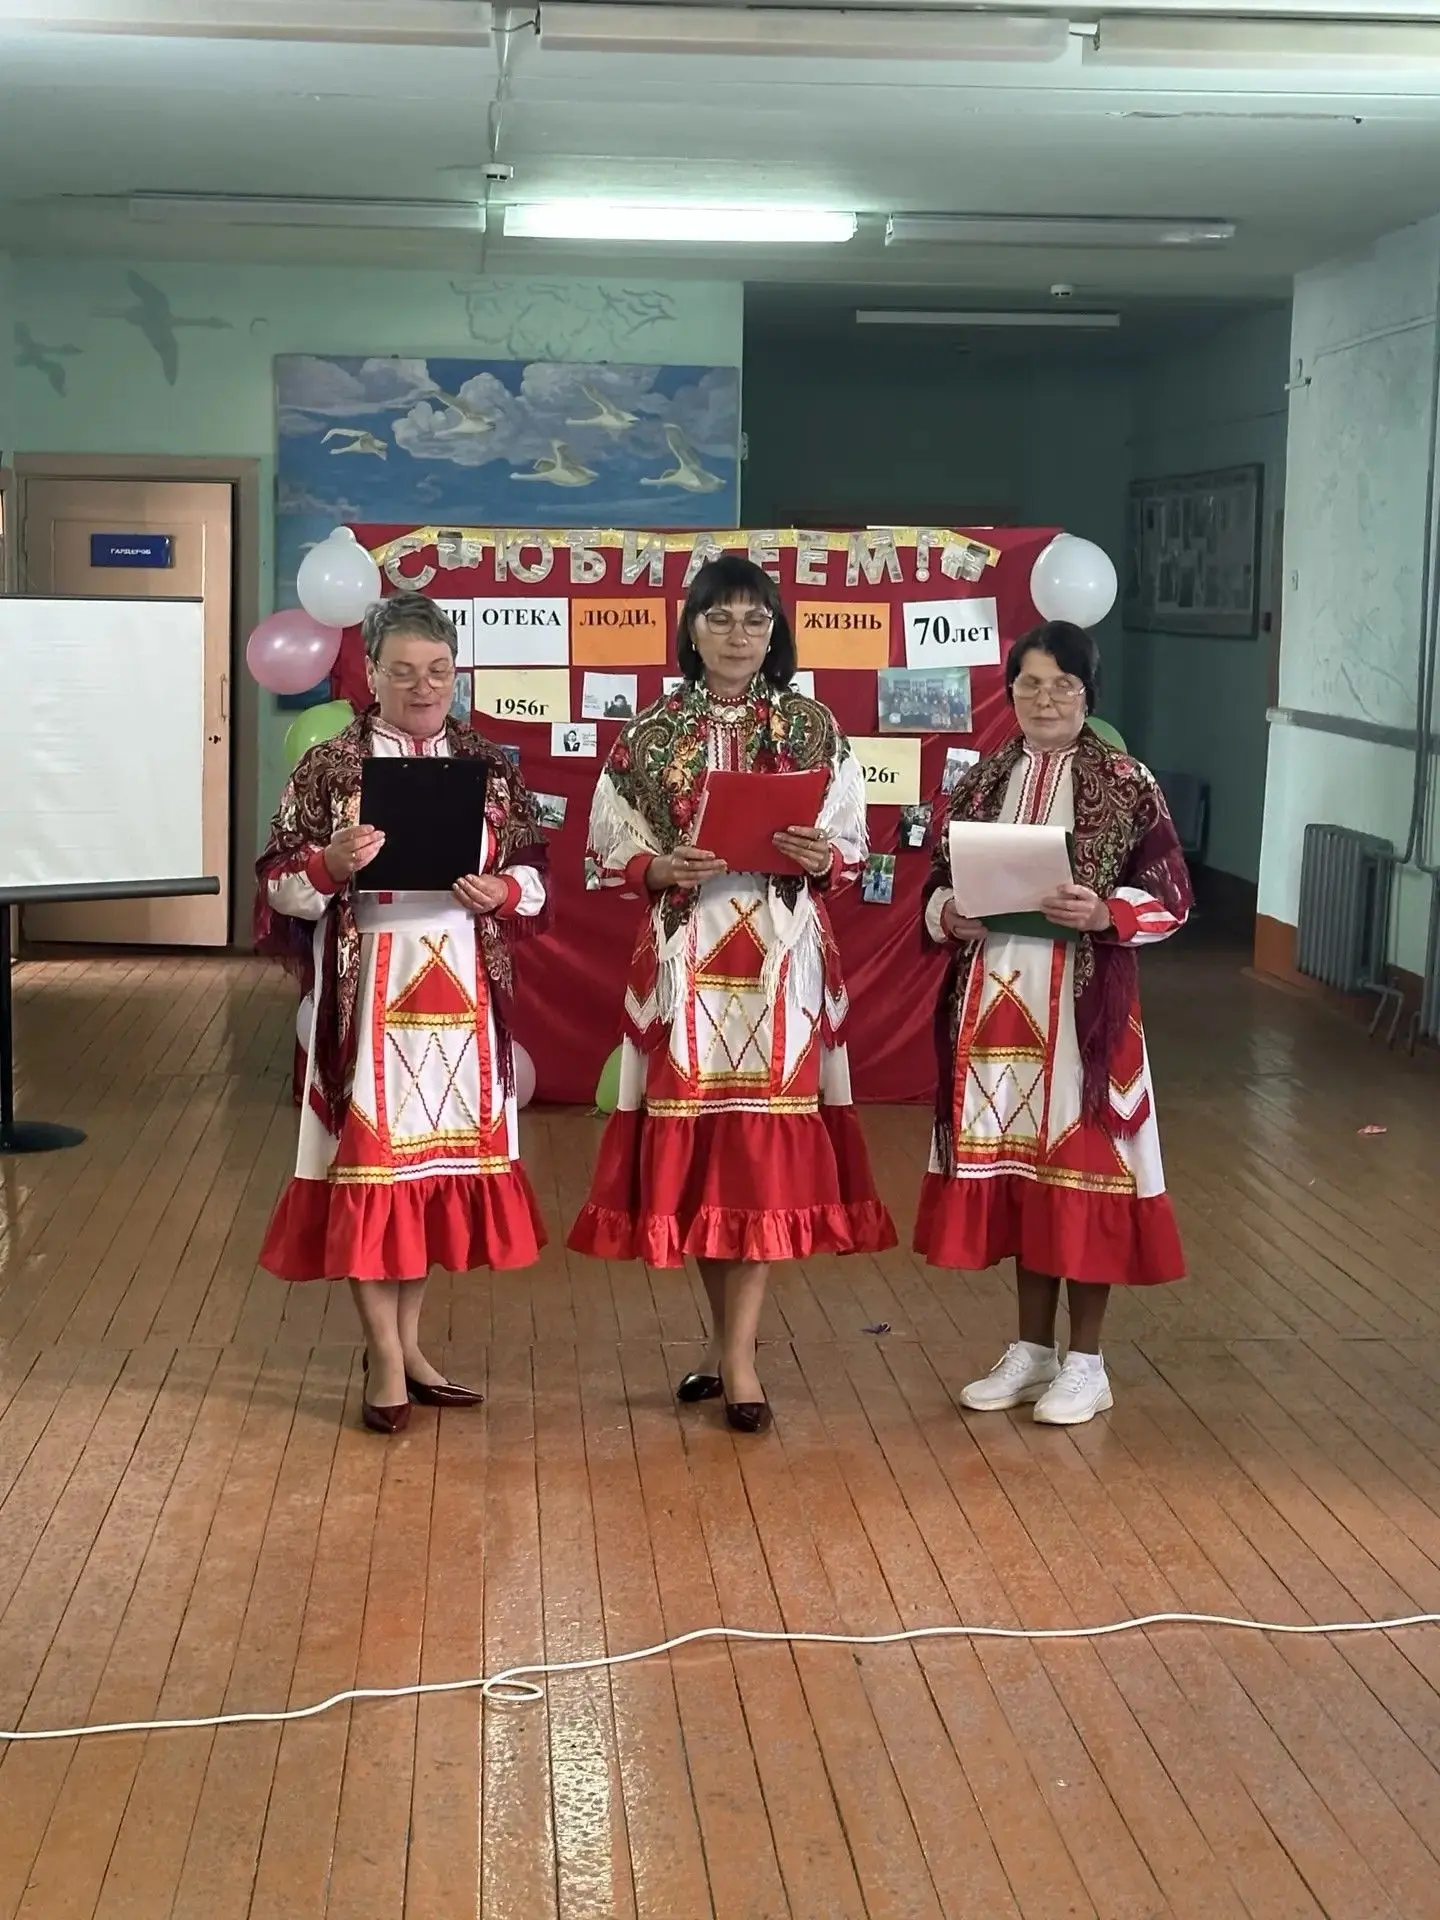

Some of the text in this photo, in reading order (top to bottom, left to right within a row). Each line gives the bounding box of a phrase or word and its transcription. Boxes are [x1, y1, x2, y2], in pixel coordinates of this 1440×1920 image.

[384, 536, 437, 590] С
[482, 608, 562, 626] ОТЕКА
[579, 608, 657, 628] ЛЮДИ,
[803, 612, 883, 630] ЖИЗНЬ
[913, 616, 993, 645] 70лет
[494, 697, 550, 716] 1956г
